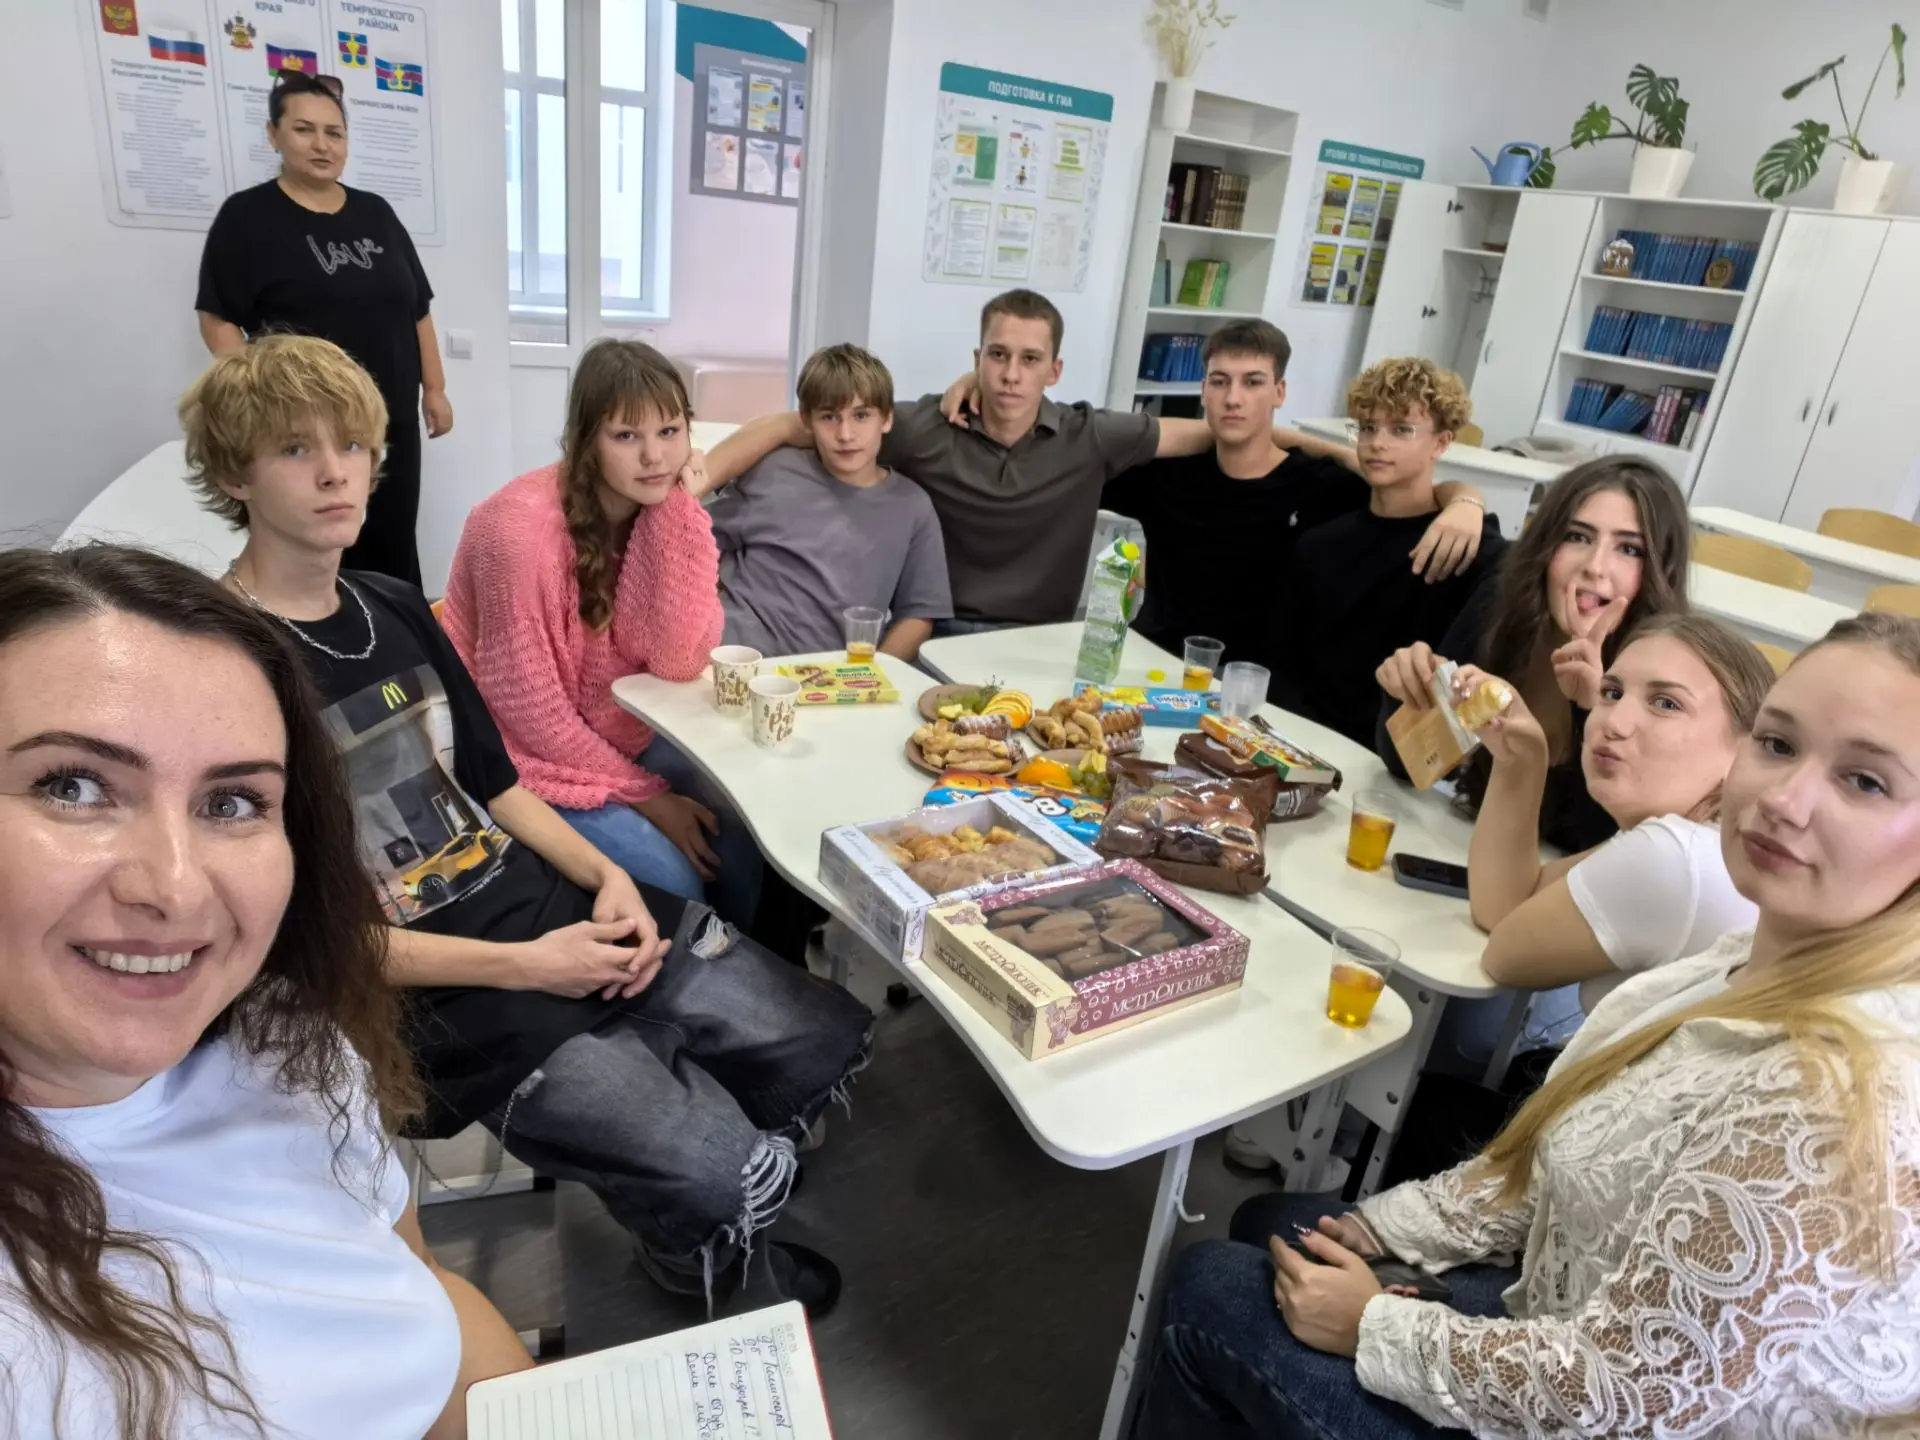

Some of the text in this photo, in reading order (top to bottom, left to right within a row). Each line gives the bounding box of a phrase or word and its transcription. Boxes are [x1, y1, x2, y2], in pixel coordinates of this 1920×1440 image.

[254, 1, 284, 14] КРАЯ
[340, 1, 415, 23] ТЕМРЮКСКОГО
[357, 17, 400, 32] РАЙОНА
[988, 80, 1074, 108] ПОДГОТОВКА К ГИА
[728, 1337, 744, 1355] 10
